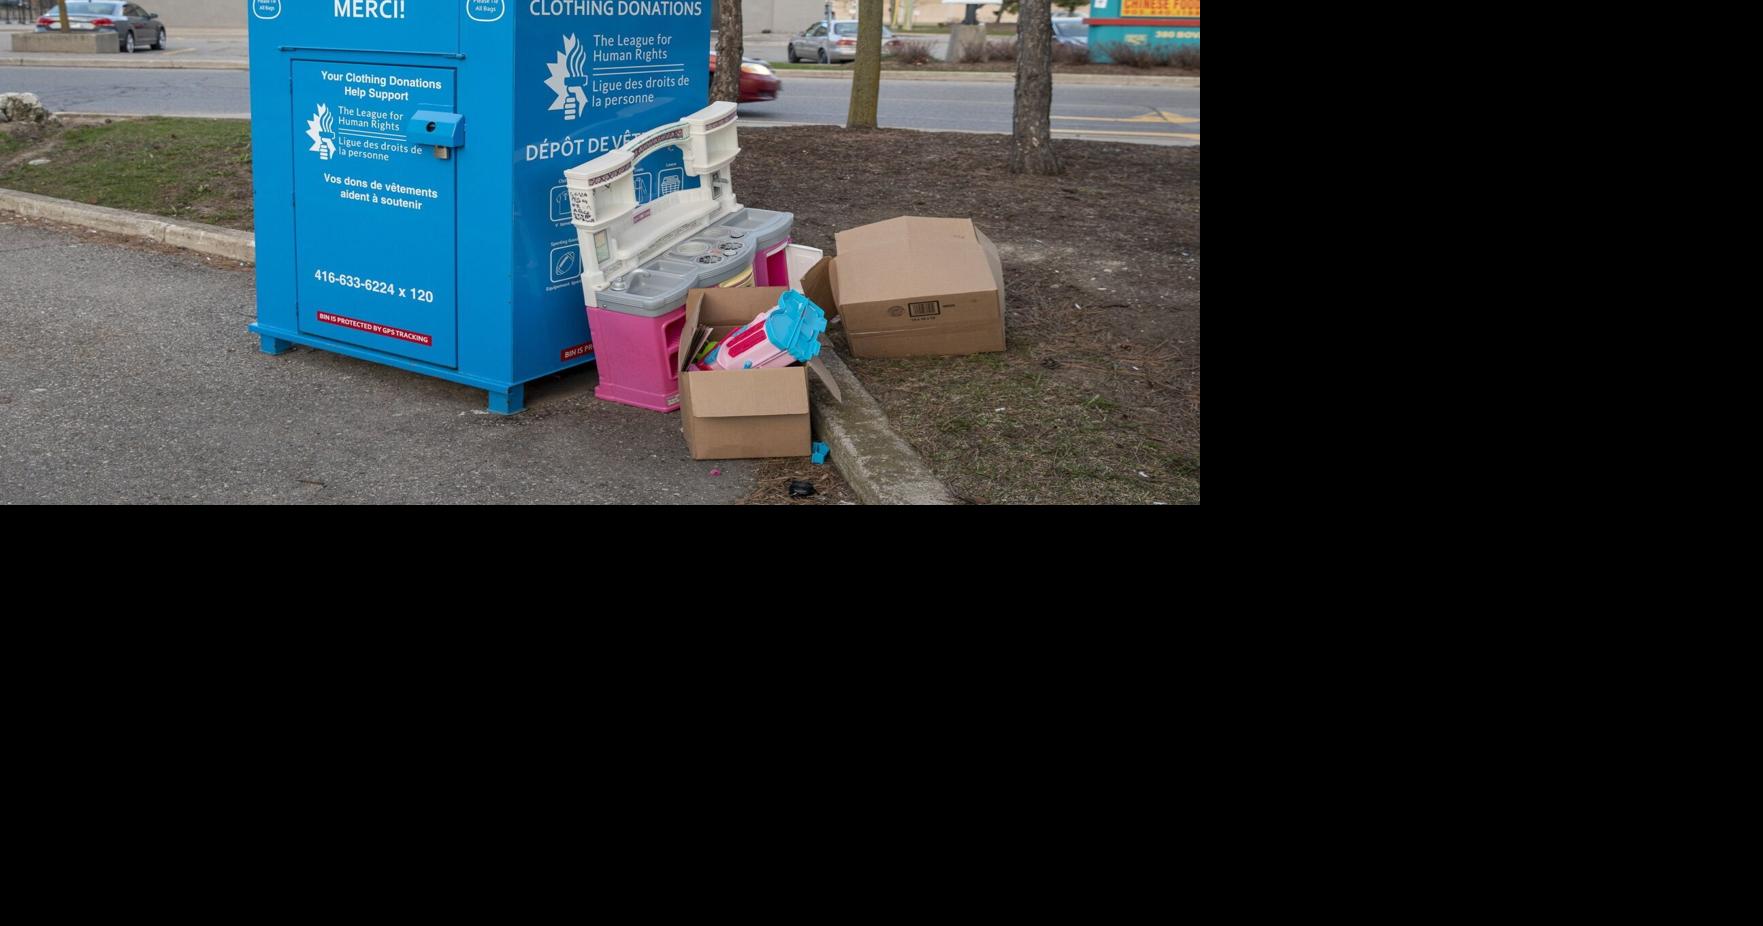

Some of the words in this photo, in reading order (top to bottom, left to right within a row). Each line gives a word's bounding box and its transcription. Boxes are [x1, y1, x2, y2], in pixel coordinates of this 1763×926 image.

[334, 0, 405, 19] MERCI!
[529, 0, 614, 16] CLOTHING
[618, 0, 702, 16] DONATIONS
[593, 35, 614, 47] The
[617, 34, 654, 48] League
[657, 33, 672, 45] for
[593, 50, 632, 62] Human
[635, 48, 668, 62] Rights
[321, 71, 343, 81] Your
[345, 72, 386, 87] Clothing
[389, 76, 442, 89] Donations
[592, 80, 622, 94] Ligue
[625, 78, 643, 91] des
[645, 76, 675, 88] droits
[677, 75, 690, 86] de
[344, 86, 366, 98] Help
[368, 88, 409, 101] Support
[592, 96, 601, 107] la
[604, 93, 654, 108] personne
[338, 105, 354, 116] The
[356, 108, 388, 120] League
[390, 111, 404, 121] for
[338, 117, 369, 127] Human
[371, 119, 400, 131] Rights
[338, 137, 362, 148] Ligue
[364, 139, 379, 148] des
[381, 142, 409, 153] droits
[410, 145, 423, 155] de
[338, 147, 347, 155] la
[348, 149, 389, 161] personne
[526, 136, 585, 161] DÉPÔT
[588, 136, 609, 153] DE
[324, 173, 342, 185] Vos
[344, 176, 368, 189] dons
[370, 179, 383, 191] de
[385, 181, 438, 199] vêtements
[340, 190, 370, 203] aident
[372, 194, 379, 204] à
[380, 196, 423, 210] soutenir
[314, 269, 395, 296] 416-633-6224
[398, 288, 407, 298] x
[410, 287, 434, 303] 120
[319, 312, 330, 321] BIN
[337, 317, 373, 331] PROTECTED
[372, 325, 382, 333] BY
[382, 327, 396, 336] GPS
[395, 330, 429, 343] TRACKING
[564, 350, 577, 359] BIN
[577, 346, 584, 354] IS
